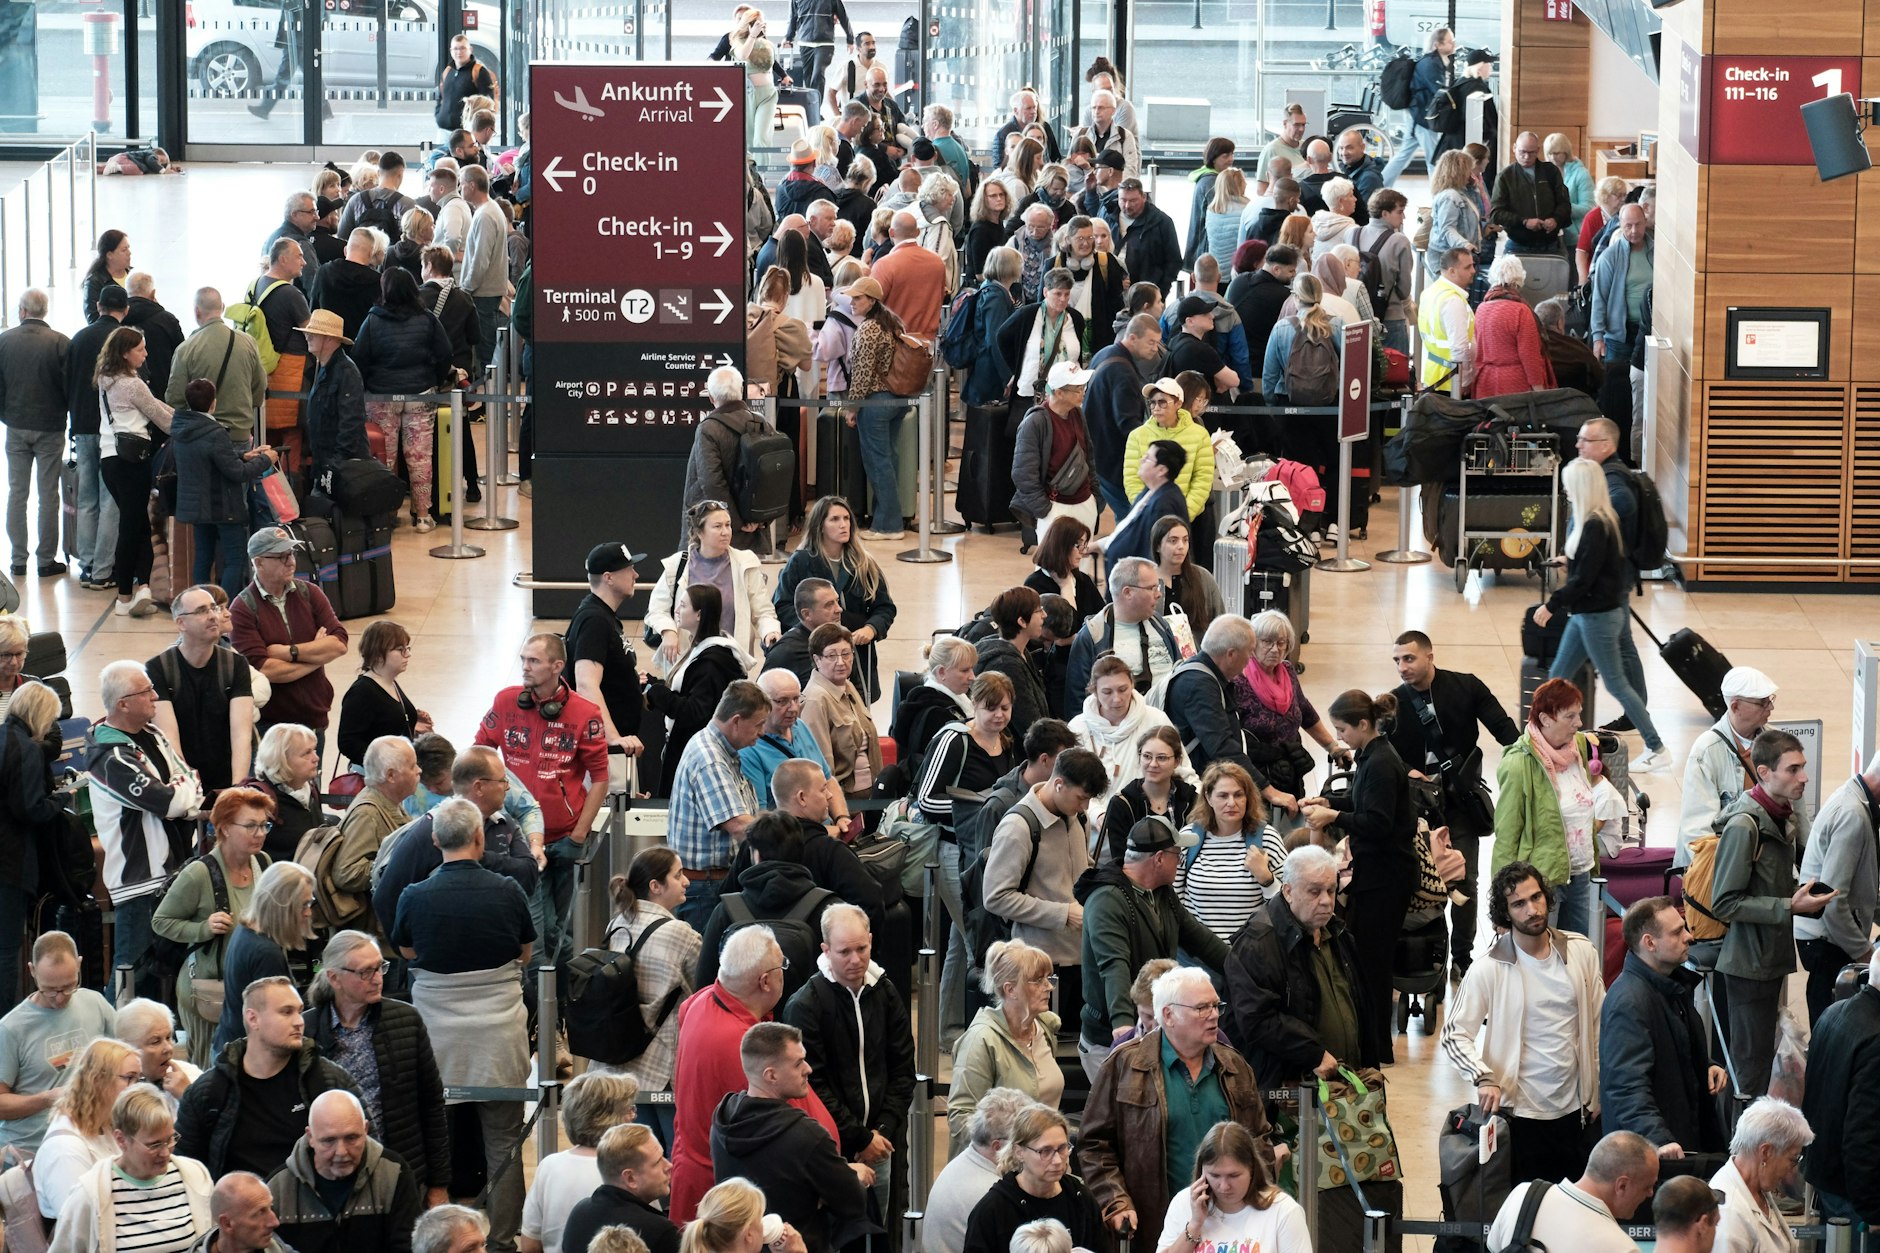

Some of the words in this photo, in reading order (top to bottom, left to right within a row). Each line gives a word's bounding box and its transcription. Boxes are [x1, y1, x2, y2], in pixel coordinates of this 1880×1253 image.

[1725, 67, 1790, 81] Check-in
[601, 81, 693, 101] Ankunft
[638, 107, 693, 122] Arrival
[583, 152, 678, 171] Check-in
[583, 176, 597, 195] 0
[597, 216, 693, 236] Check-in
[653, 241, 693, 260] 1–9
[543, 288, 616, 304] Terminal
[625, 298, 650, 315] T2
[575, 309, 600, 321] 500
[604, 311, 616, 321] m
[641, 353, 666, 361] Airline
[668, 353, 696, 361] Service
[665, 362, 696, 370] Counter
[555, 381, 583, 390] Airport
[567, 390, 583, 399] City
[128, 773, 151, 797] 63
[650, 1093, 672, 1103] BER
[1268, 1090, 1290, 1100] BER
[1628, 1226, 1651, 1237] BER
